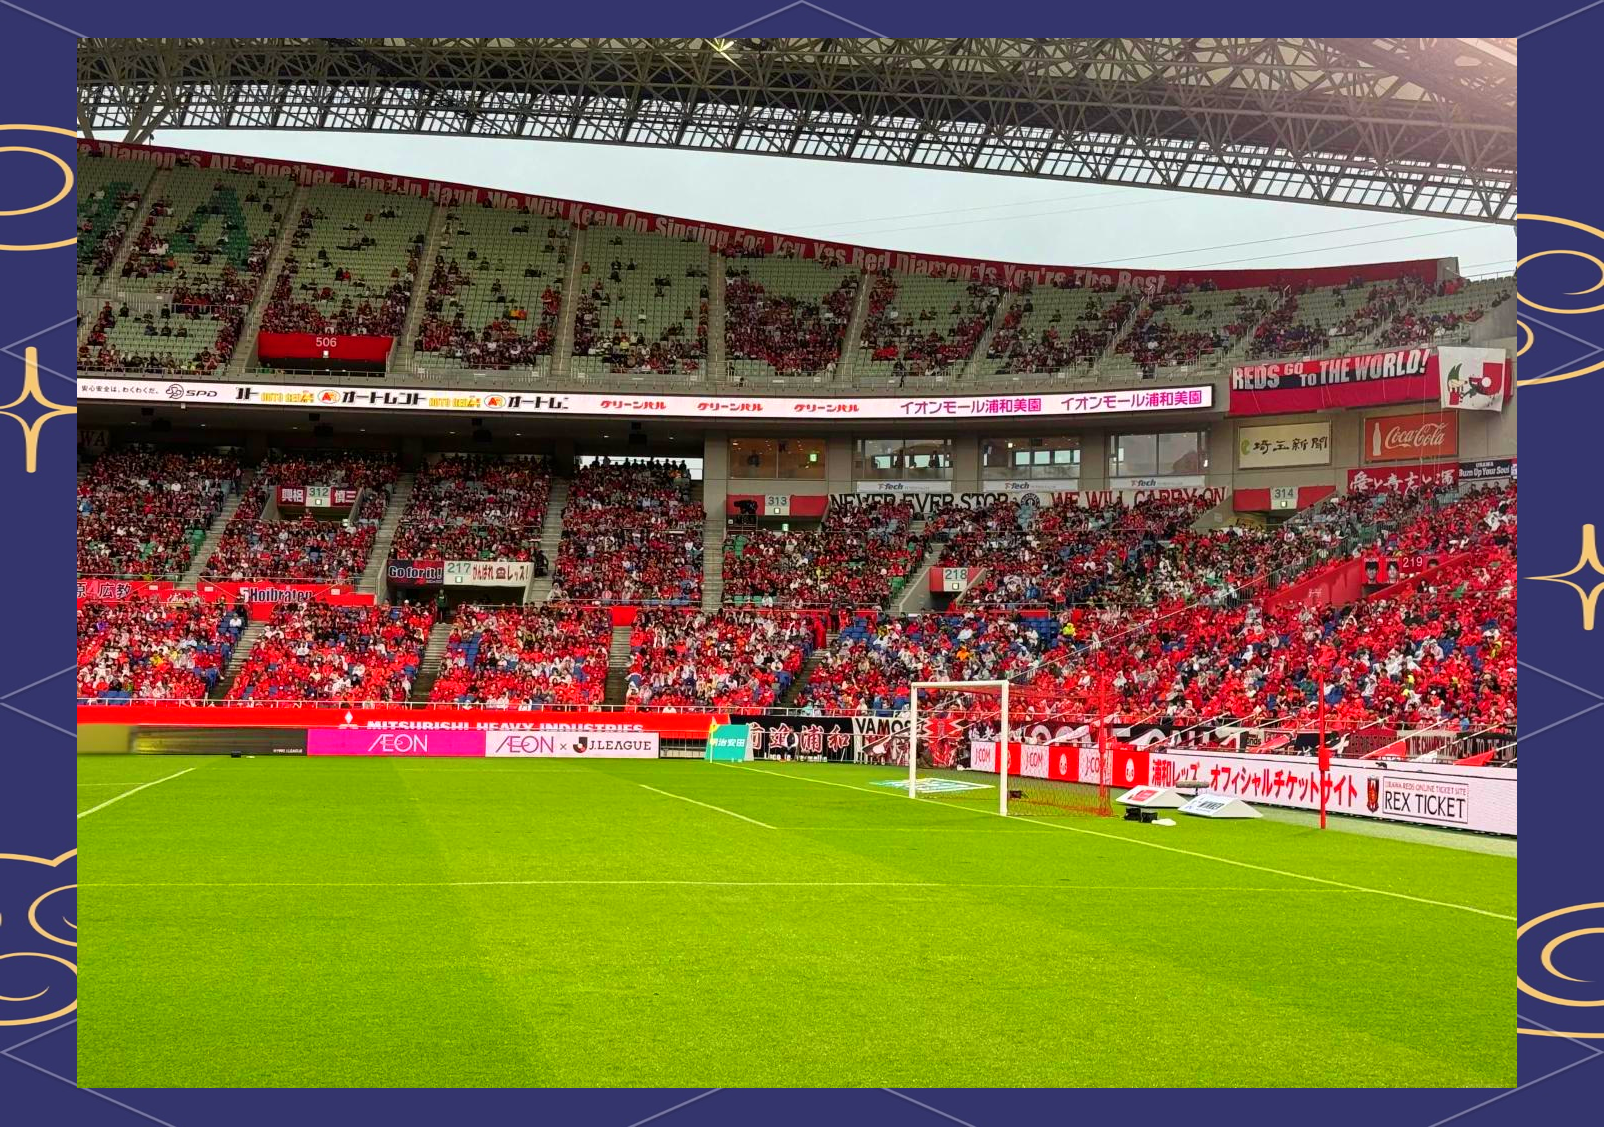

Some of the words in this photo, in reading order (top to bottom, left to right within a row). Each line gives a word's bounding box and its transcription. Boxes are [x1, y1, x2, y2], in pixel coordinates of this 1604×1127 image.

[622, 212, 649, 233] On
[316, 337, 337, 347] 506
[1233, 364, 1280, 390] REDS
[1284, 362, 1303, 376] GO
[1319, 357, 1351, 384] THE
[1353, 349, 1431, 378] WORLD!
[186, 389, 218, 398] SPD
[900, 398, 1041, 414] イオンモール浦和美園
[1061, 390, 1202, 411] イオンモール浦和美園
[1482, 467, 1497, 476] Your
[309, 487, 329, 497] 312
[1274, 487, 1294, 499] 314
[767, 495, 787, 506] 313
[447, 562, 471, 573] 217
[1402, 556, 1423, 568] 219
[388, 565, 404, 578] Go
[944, 569, 967, 580] 218
[588, 739, 652, 751] J.LEAGUE
[1152, 759, 1201, 790] 浦和レッズ
[1210, 764, 1358, 807] オフィシャルチケットサイト
[1385, 791, 1411, 812] REX
[1415, 794, 1466, 818] TICKET
